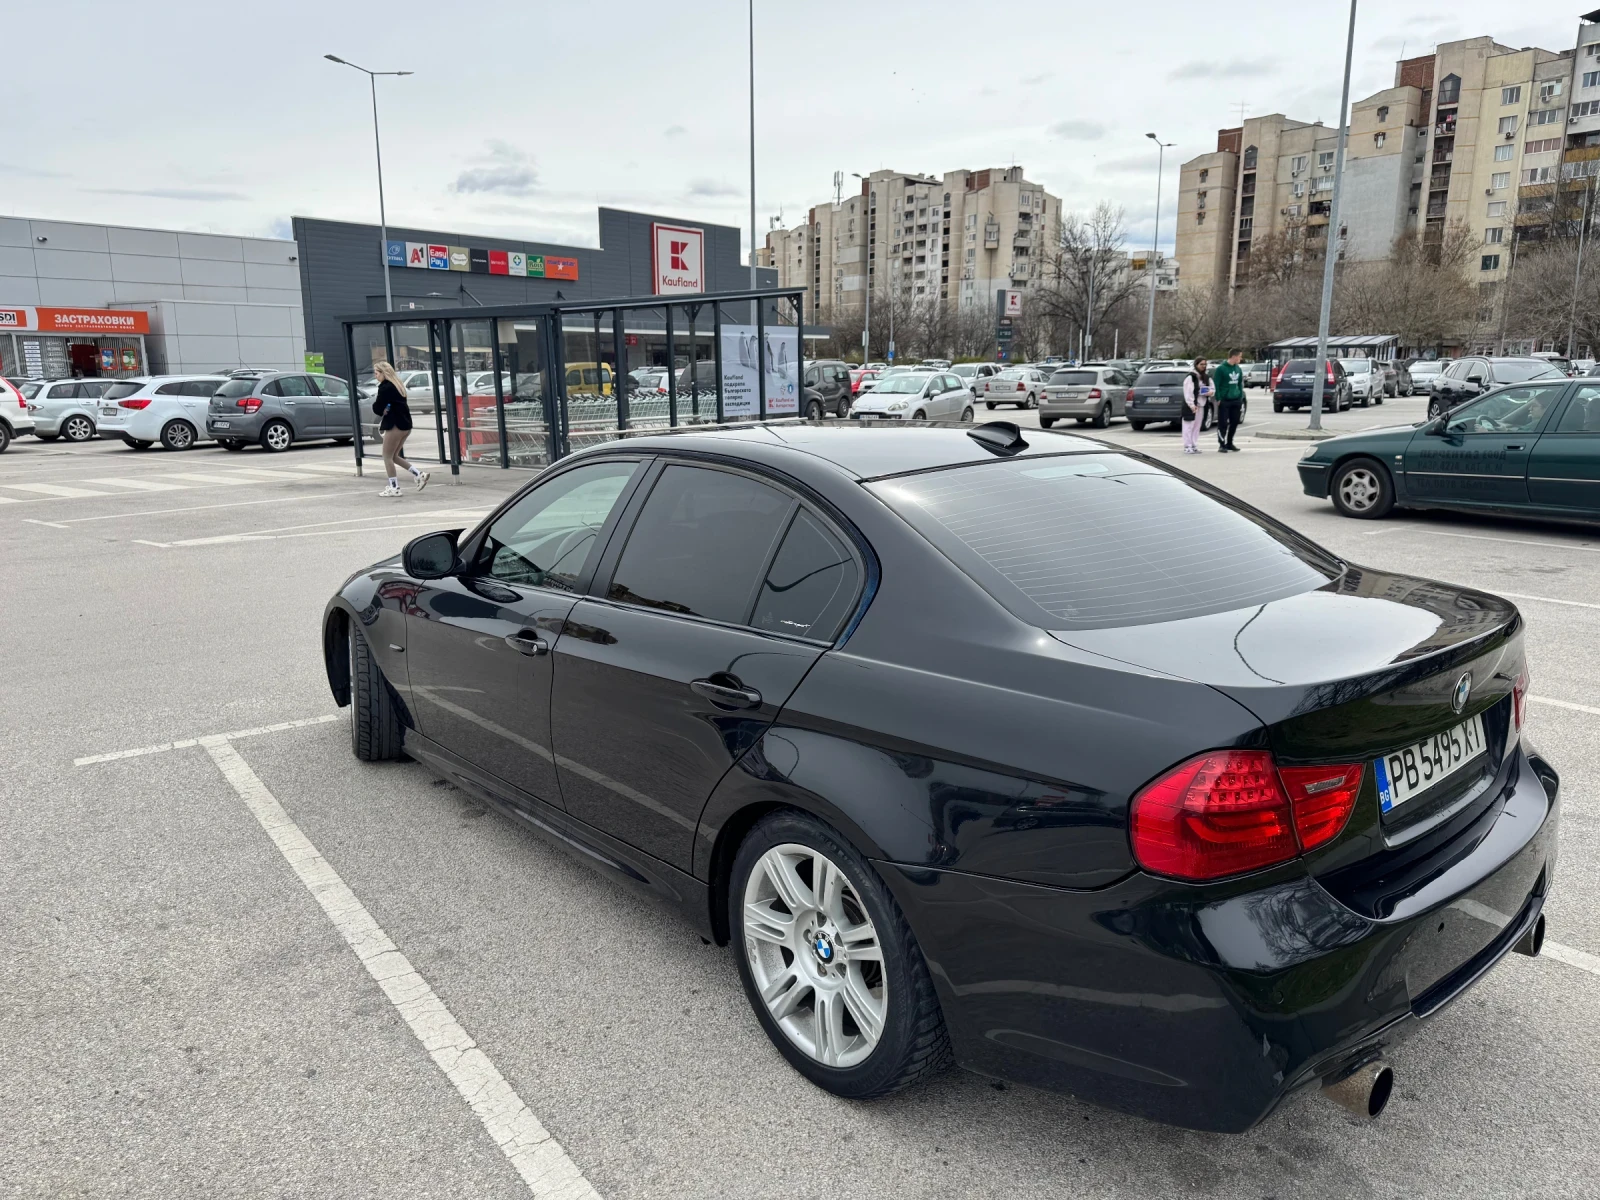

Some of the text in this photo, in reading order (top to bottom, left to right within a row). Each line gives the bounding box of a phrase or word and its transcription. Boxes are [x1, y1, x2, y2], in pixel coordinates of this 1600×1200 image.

[410, 247, 424, 263] A1
[429, 249, 447, 259] Easy
[430, 258, 444, 267] Pay
[662, 275, 698, 288] Kaufland
[54, 314, 135, 326] ЗАСТРАХОВКИ
[1419, 730, 1461, 780] 5495
[1379, 789, 1390, 804] BG
